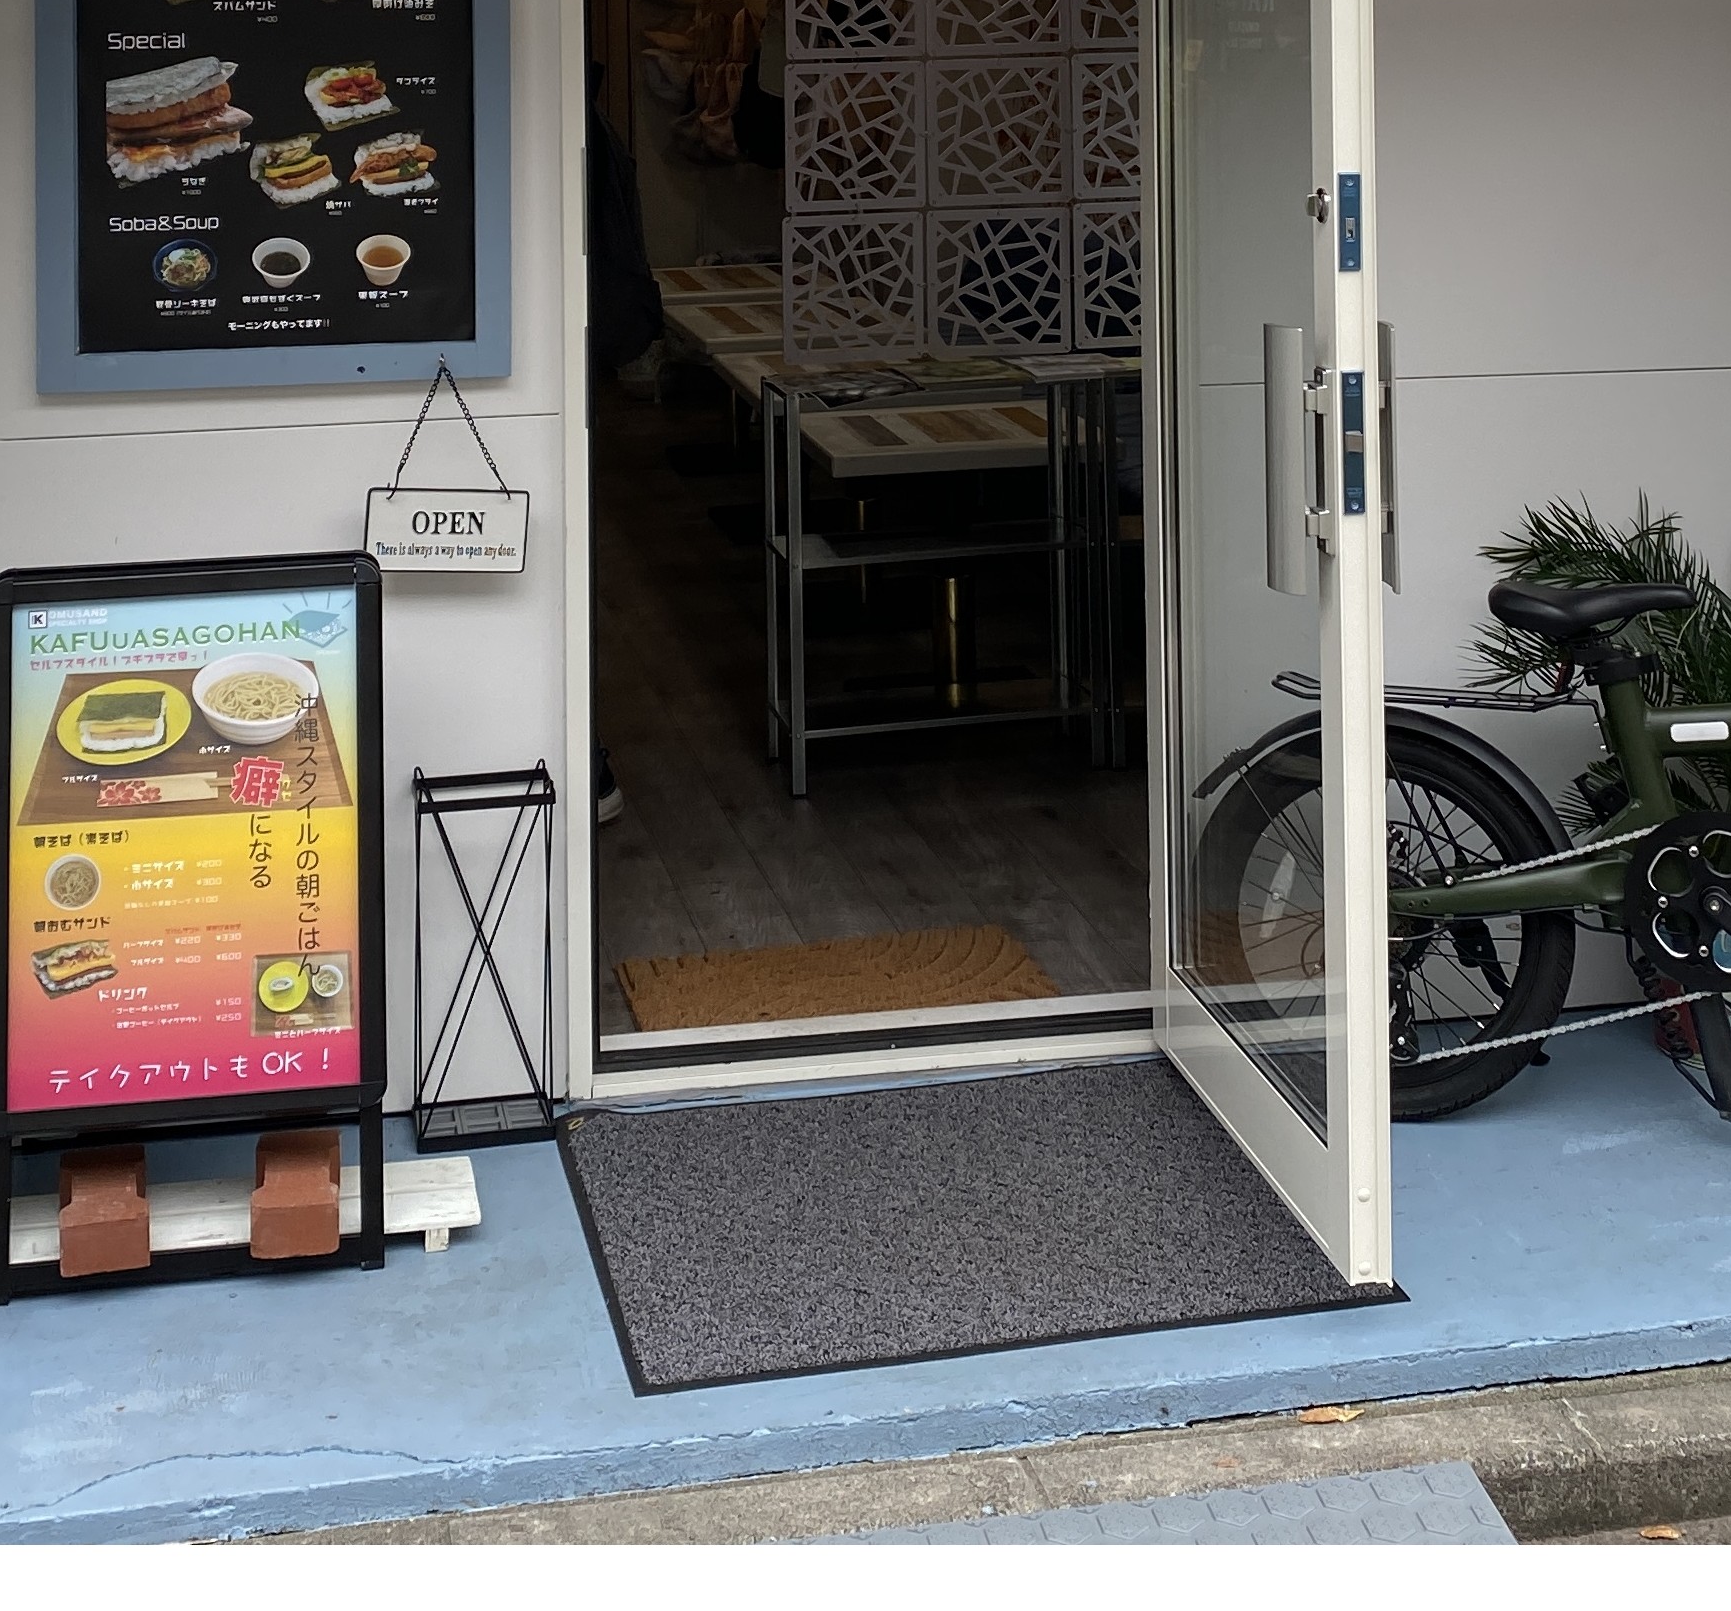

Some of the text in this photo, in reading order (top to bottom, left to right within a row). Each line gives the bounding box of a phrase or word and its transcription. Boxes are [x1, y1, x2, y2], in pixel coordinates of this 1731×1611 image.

[107, 33, 186, 51] Special
[109, 216, 220, 233] Soba&Soup
[412, 511, 485, 534] OPEN
[376, 542, 516, 559] There is always a way to open any door.
[294, 693, 321, 978] 沖縄スタイルの朝ごはん
[98, 987, 148, 1002] ドリンク
